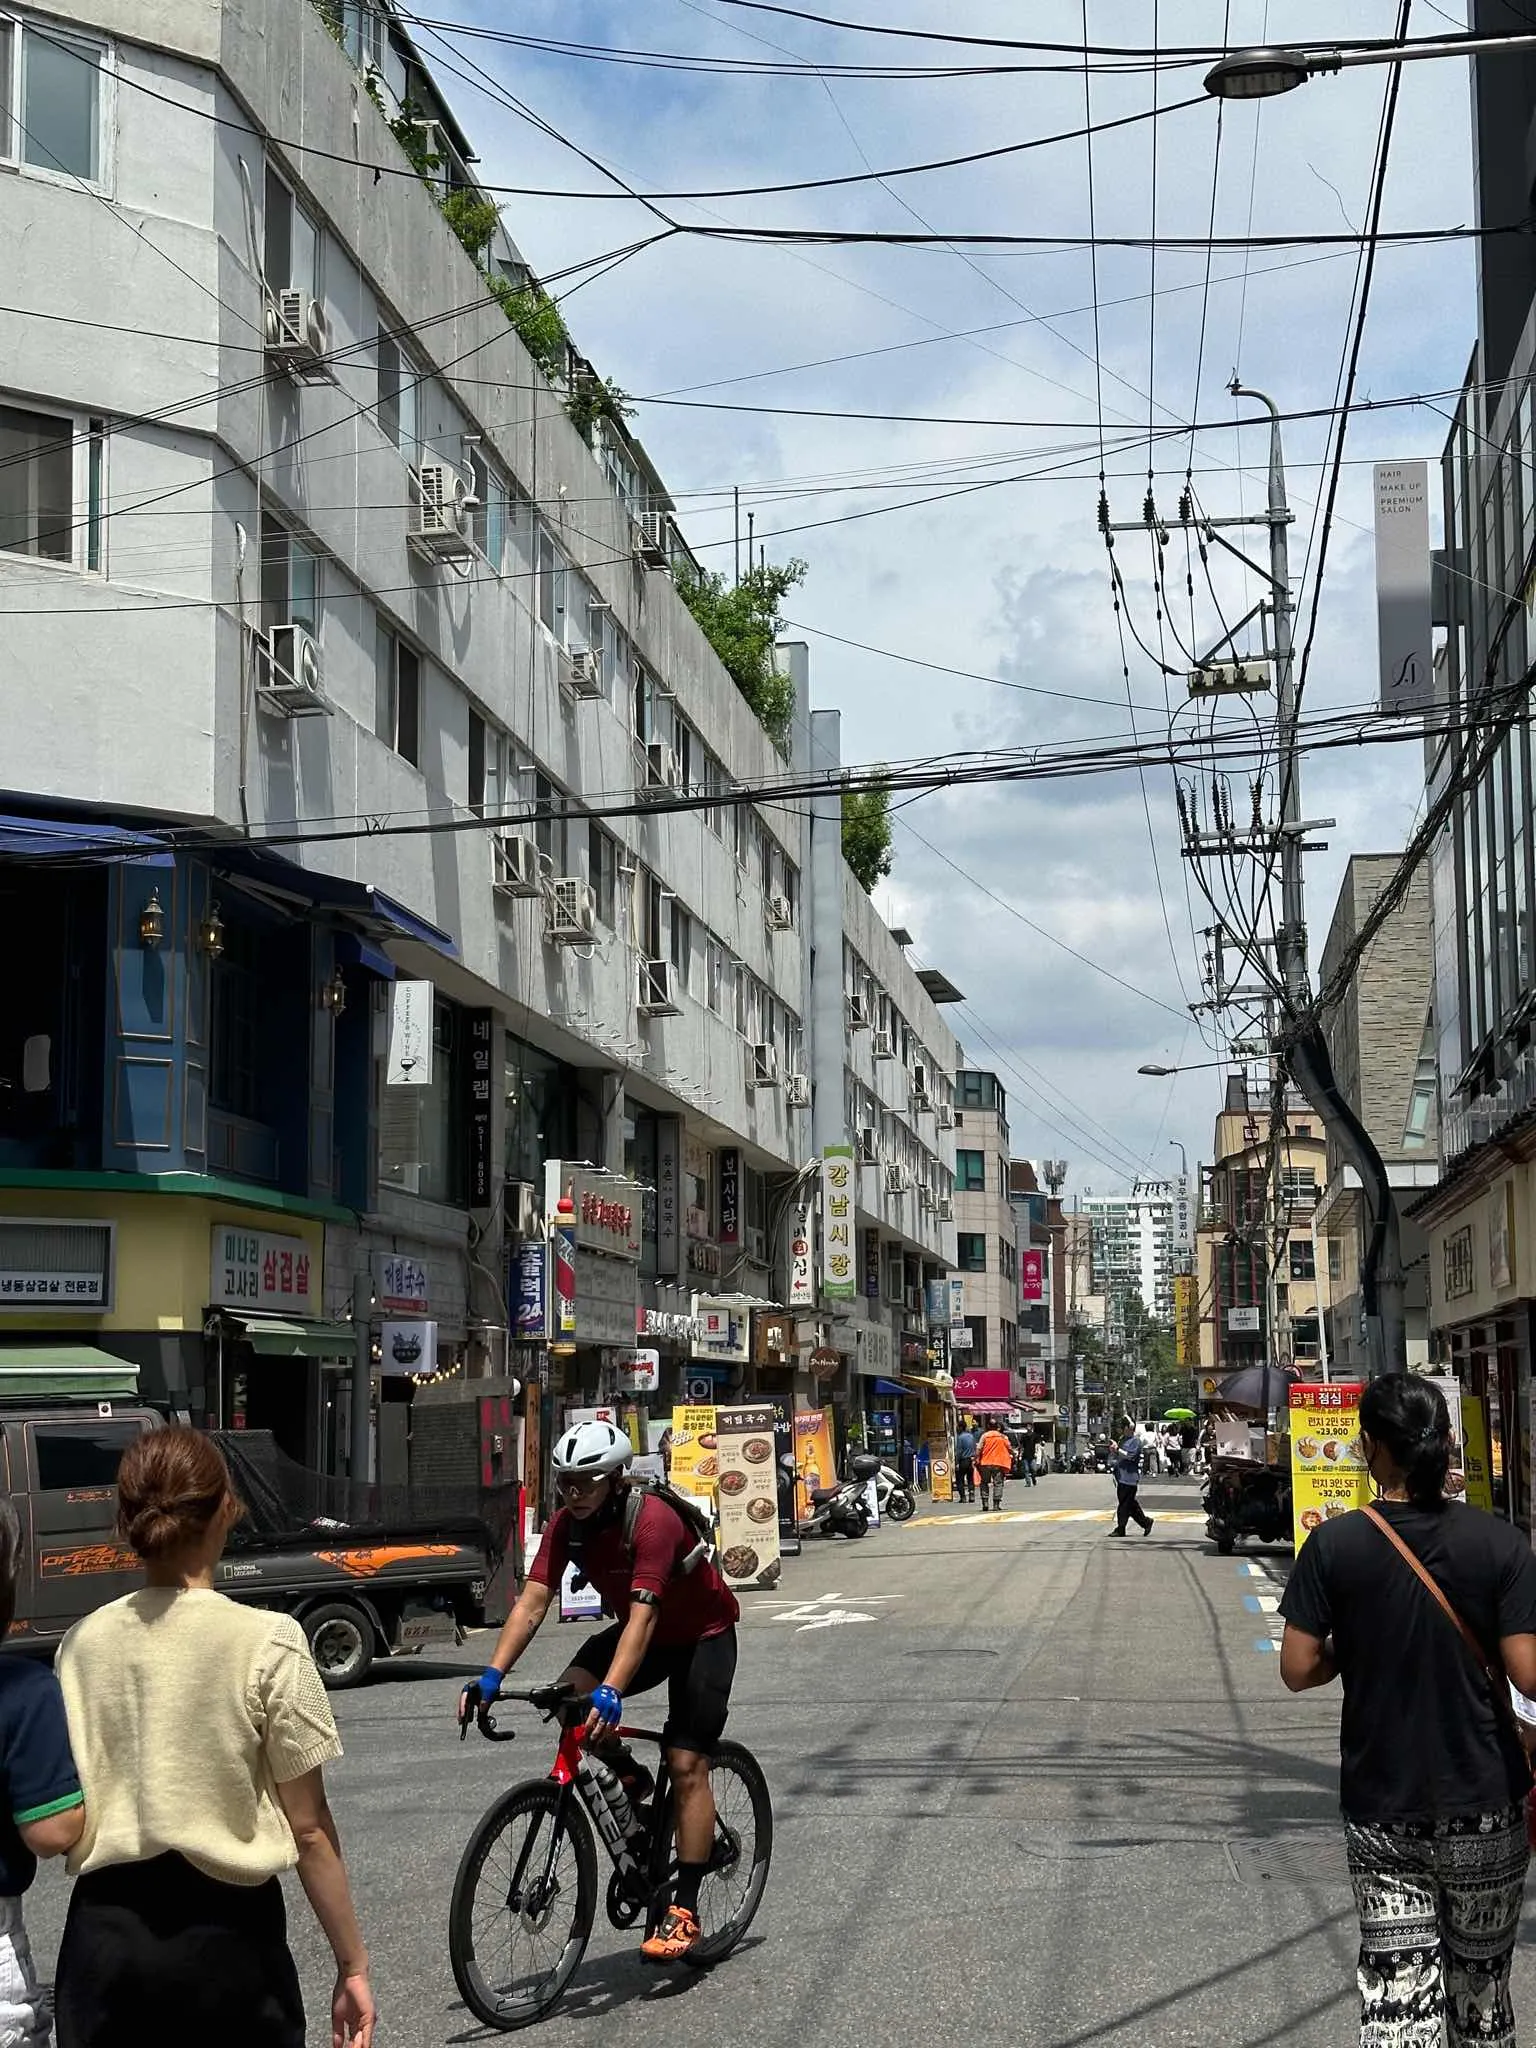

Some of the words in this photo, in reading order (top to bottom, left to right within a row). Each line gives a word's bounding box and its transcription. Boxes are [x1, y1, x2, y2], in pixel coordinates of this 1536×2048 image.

[1380, 484, 1406, 492] MAKE
[1380, 496, 1423, 505] PREMIUM
[1381, 505, 1411, 514] SALON
[473, 1021, 489, 1099] 네일랩
[723, 1159, 737, 1233] 보신탕
[828, 1165, 850, 1277] 강남시장
[225, 1234, 259, 1265] 미나리
[264, 1250, 309, 1294] 삼겹살
[1, 1279, 60, 1293] 냉동삼겹살
[65, 1280, 98, 1293] 전문점
[225, 1269, 259, 1298] 고사리
[518, 1302, 543, 1321] 24
[1030, 1385, 1041, 1395] 24
[1319, 1392, 1342, 1405] 점심
[1341, 1418, 1355, 1427] SET
[1330, 1479, 1343, 1488] 3인
[1345, 1479, 1359, 1488] SET
